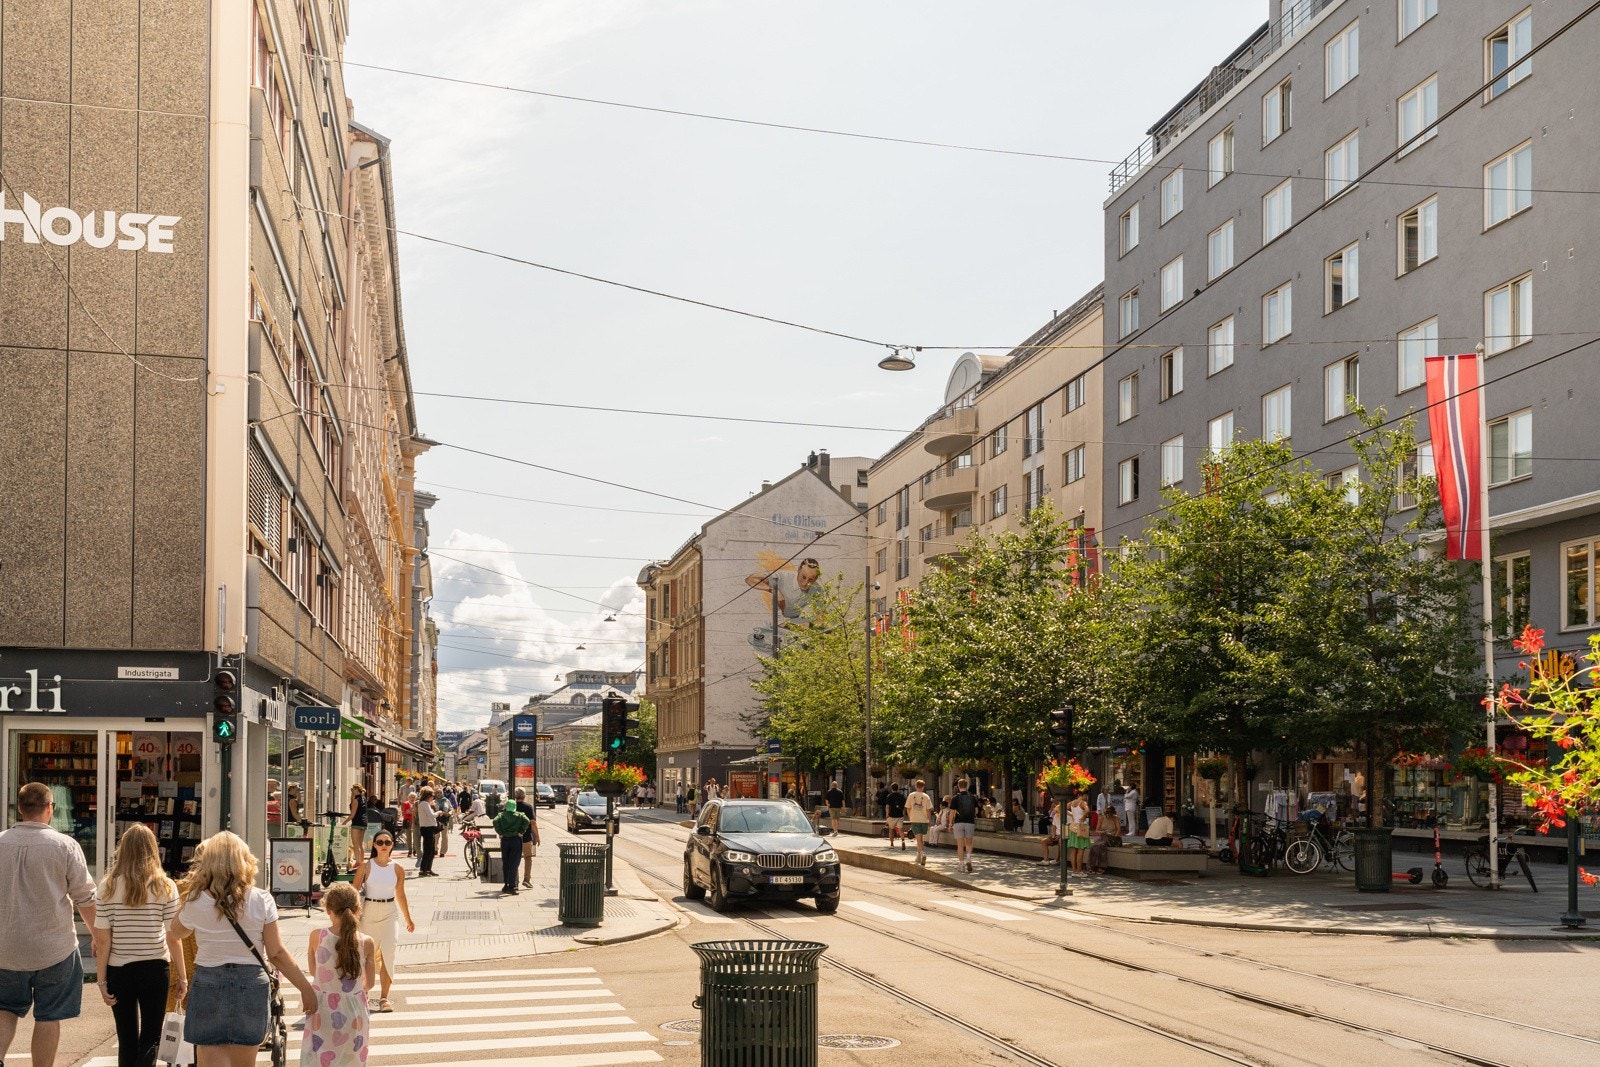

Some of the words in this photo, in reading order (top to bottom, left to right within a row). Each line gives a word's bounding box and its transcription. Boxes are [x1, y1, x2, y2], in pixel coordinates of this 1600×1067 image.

[772, 513, 792, 526] Clas
[793, 514, 827, 528] Ohlson
[124, 669, 172, 679] Industrigata
[0, 669, 67, 713] rli
[300, 712, 336, 725] norli
[279, 865, 300, 876] 30%
